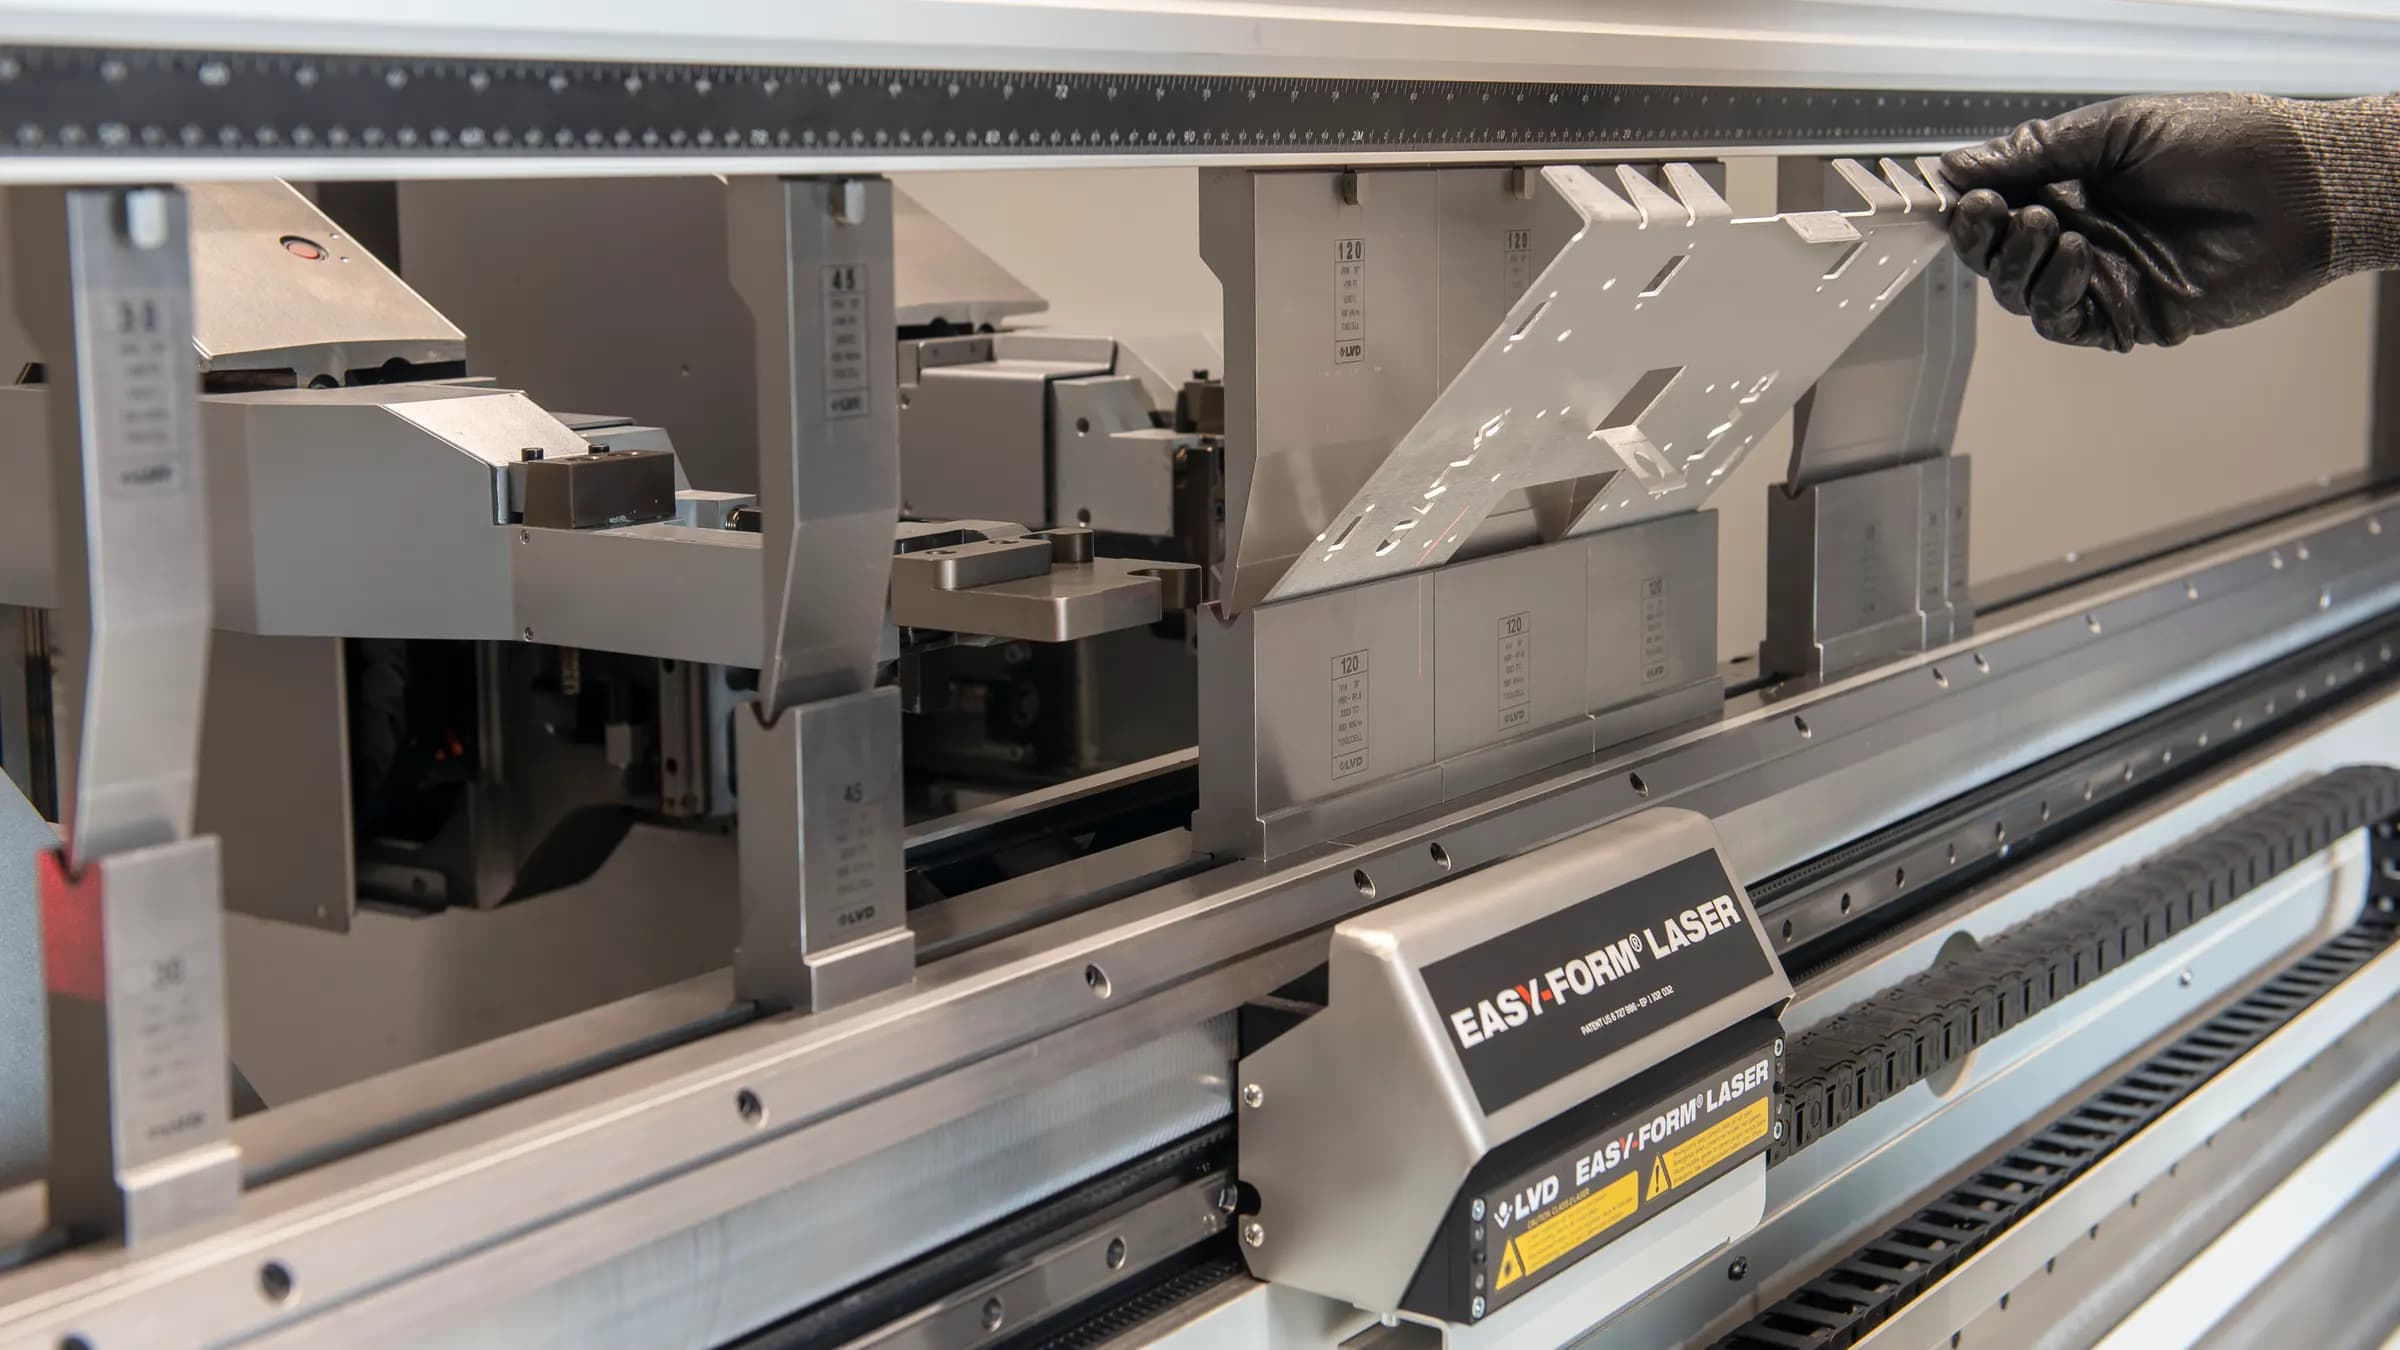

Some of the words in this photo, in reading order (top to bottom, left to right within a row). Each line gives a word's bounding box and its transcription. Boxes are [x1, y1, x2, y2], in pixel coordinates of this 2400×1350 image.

[1508, 232, 1528, 249] 120
[1338, 241, 1362, 260] 120
[1507, 617, 1522, 635] 120
[1340, 655, 1359, 675] 120
[1345, 756, 1363, 770] LVD
[1643, 894, 1743, 960] LASER
[1580, 1018, 1604, 1036] PATENT
[1514, 1174, 1560, 1221] LVD
[1706, 1058, 1770, 1112] LASER
